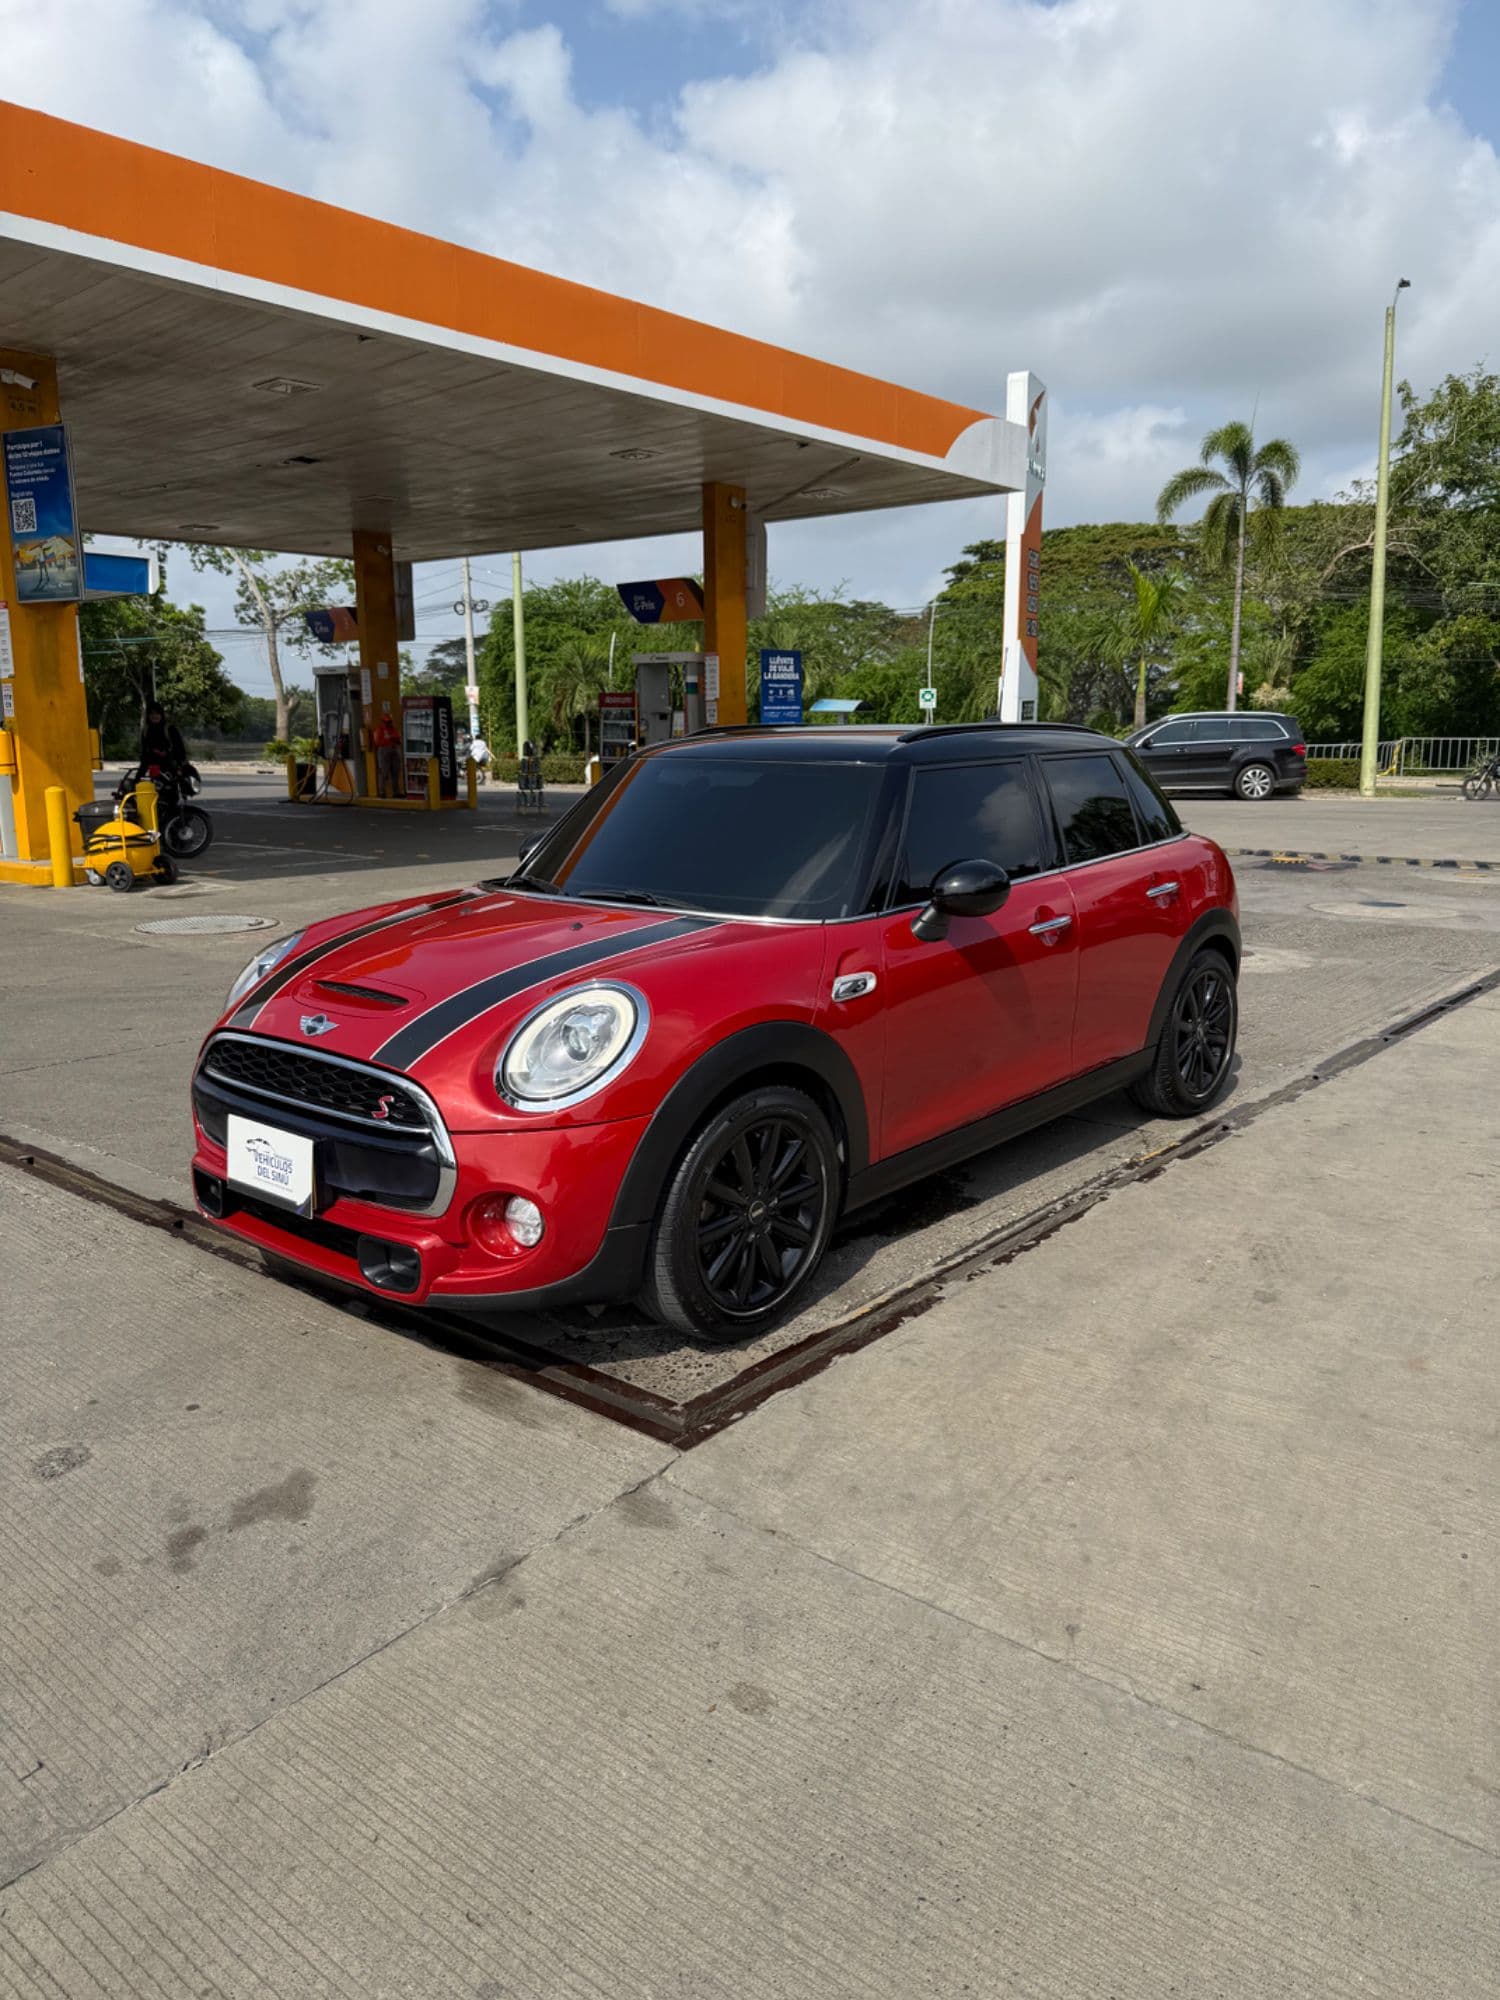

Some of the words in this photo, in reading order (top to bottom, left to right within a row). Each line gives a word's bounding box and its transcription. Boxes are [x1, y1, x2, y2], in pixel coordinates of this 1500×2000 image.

[675, 591, 686, 608] 6
[768, 656, 794, 665] LLÉVATE
[439, 707, 451, 779] distracom
[257, 1165, 271, 1179] DEL
